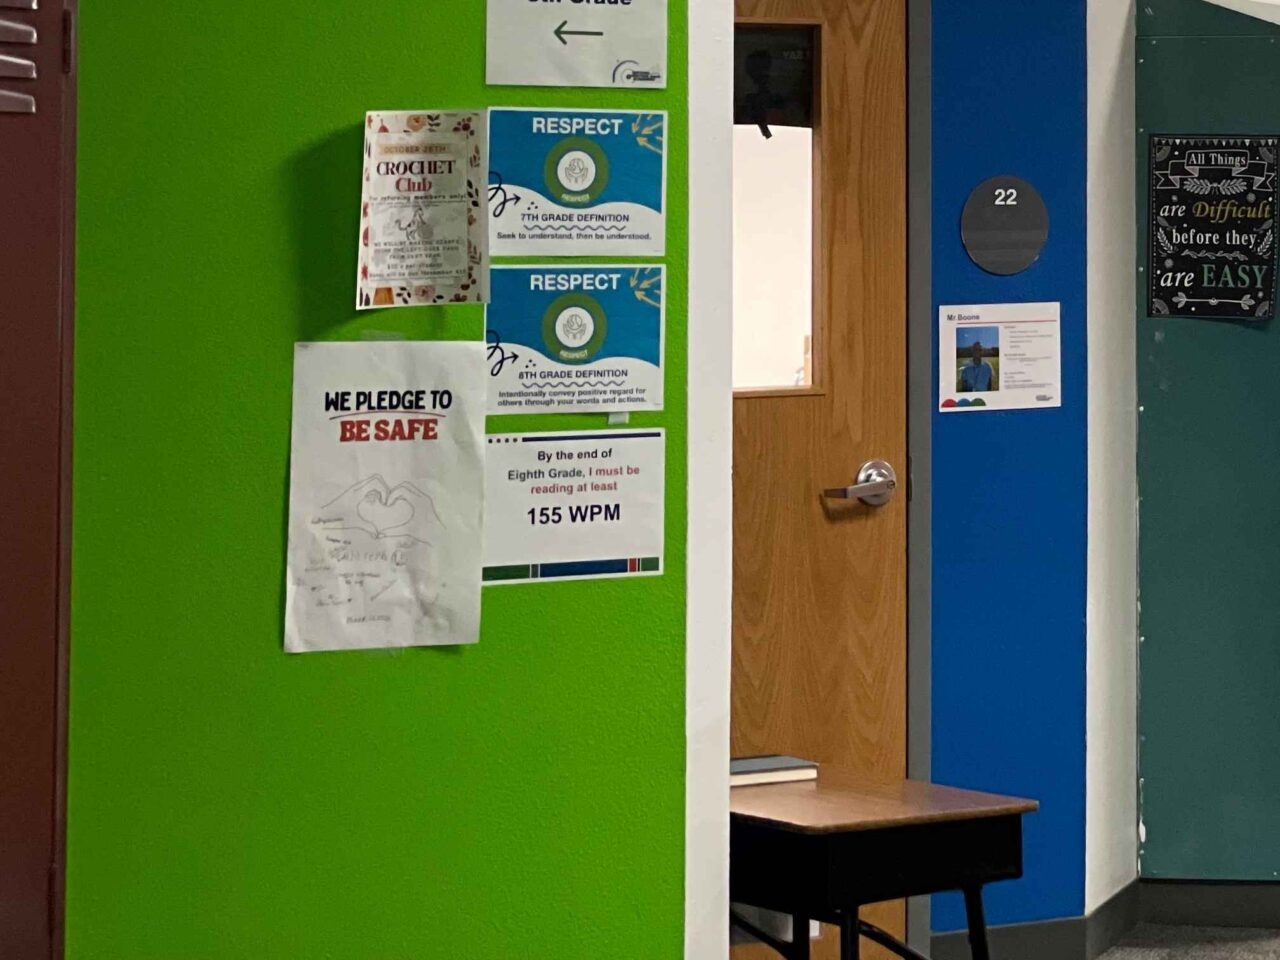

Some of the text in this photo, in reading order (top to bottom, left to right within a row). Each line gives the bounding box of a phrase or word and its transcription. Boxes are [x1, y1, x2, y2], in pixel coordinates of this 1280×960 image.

[532, 117, 624, 135] RESPECT
[375, 159, 456, 176] CROCHET
[1188, 152, 1247, 168] All Things
[394, 177, 433, 193] Club
[994, 188, 1018, 206] 22
[520, 212, 630, 223] 7TH GRADE DEFINITION
[1159, 200, 1272, 223] are Difficult
[496, 231, 517, 240] Seek
[518, 232, 527, 240] to
[576, 232, 594, 240] then
[595, 232, 605, 241] be
[1172, 228, 1258, 249] before they
[530, 273, 622, 291] RESPECT
[1159, 263, 1269, 289] are EASY
[518, 369, 629, 380] 8TH GRADE DEFINITION
[324, 389, 453, 412] WE PLEDGE TO
[497, 398, 523, 407] others
[524, 398, 555, 408] through
[557, 399, 575, 407] your
[576, 396, 601, 405] words
[602, 395, 616, 404] and
[498, 387, 646, 400] Intentionally convey positive regard for
[339, 418, 439, 442] BE SAFE
[537, 447, 613, 463] By the end of
[507, 464, 641, 483] Eighth Grade, I must be
[530, 481, 619, 496] reading at least
[526, 503, 622, 525] 155 WPM
